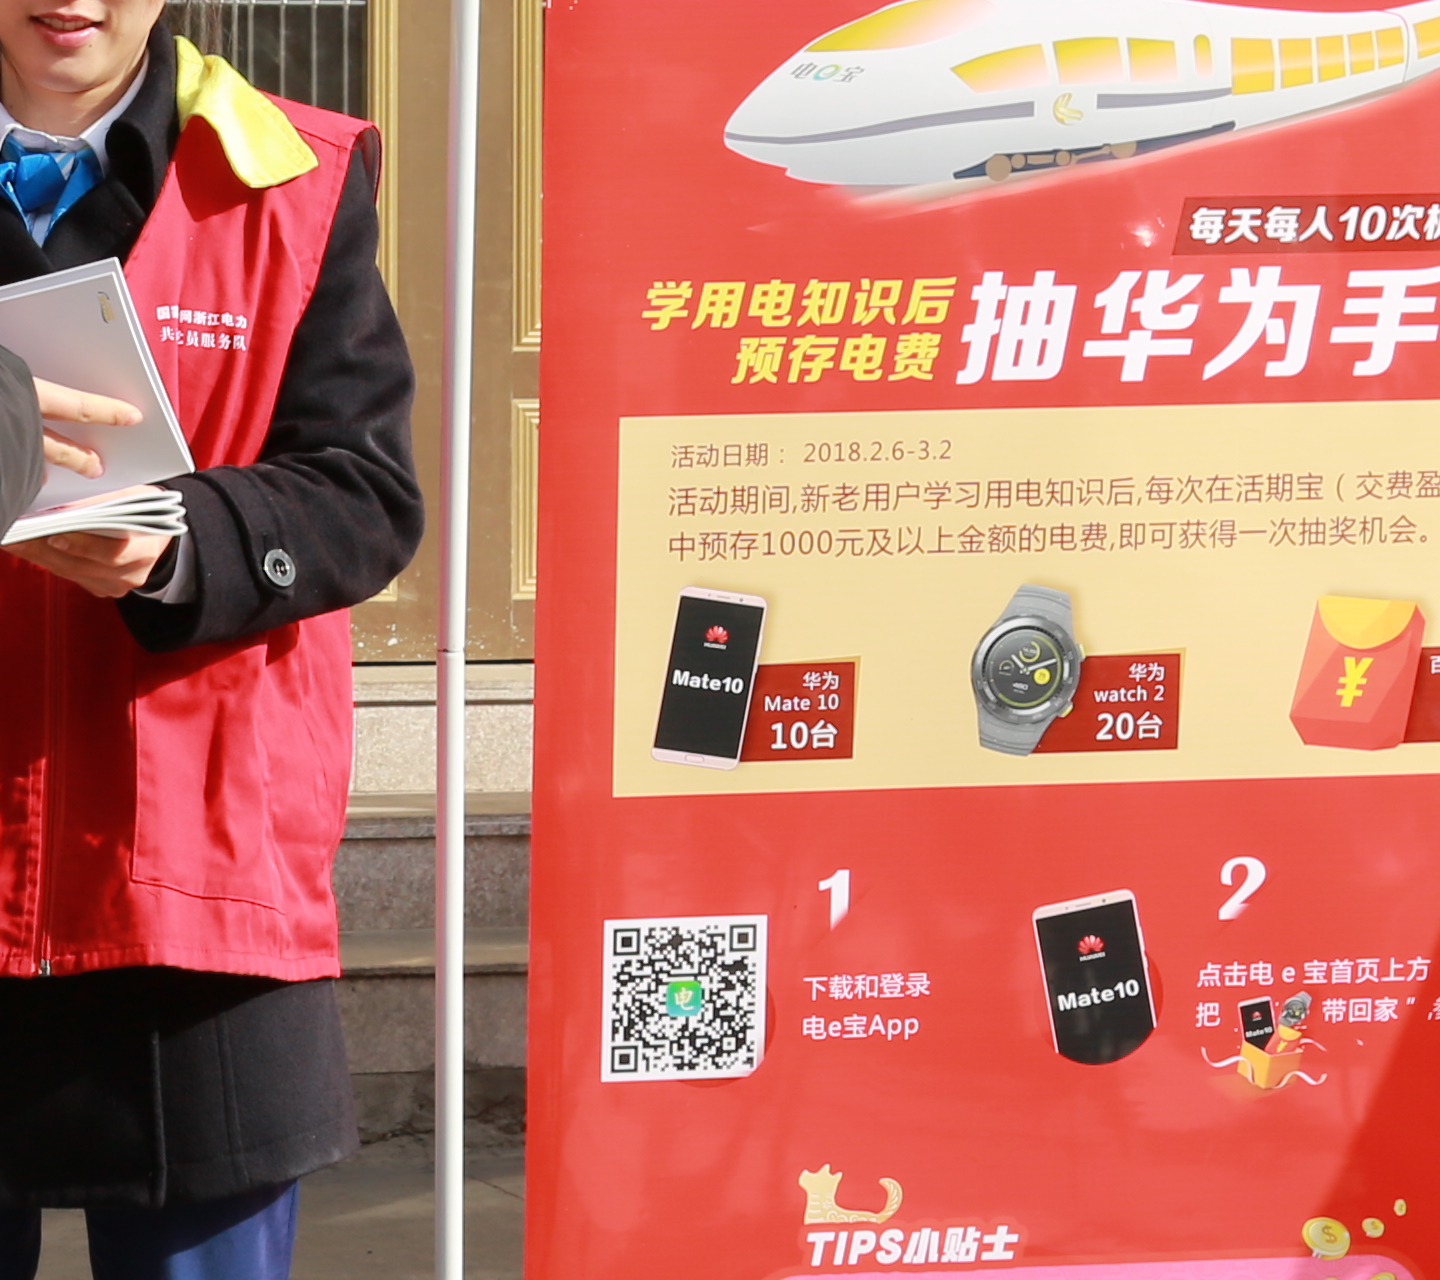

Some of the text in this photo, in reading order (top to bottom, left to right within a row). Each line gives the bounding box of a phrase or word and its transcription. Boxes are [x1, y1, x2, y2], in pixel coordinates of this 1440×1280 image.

[642, 276, 957, 331] 学用电知识后
[731, 331, 941, 384] 预存电费
[672, 669, 744, 695] Mate10
[802, 671, 840, 690] 华为
[1128, 662, 1165, 682] 华为
[764, 693, 839, 712] Mate 10
[1093, 685, 1165, 703] watch 2
[771, 720, 838, 749] 10台
[1095, 711, 1163, 740] 20台
[818, 869, 850, 929] 1
[1218, 856, 1267, 921] 2
[803, 972, 931, 1001] 下载和登录
[1057, 979, 1140, 1012] Mate10
[802, 1013, 920, 1040] 电e宝App
[1196, 1002, 1221, 1028] 把
[805, 1227, 1019, 1267] TIPS小贴士
